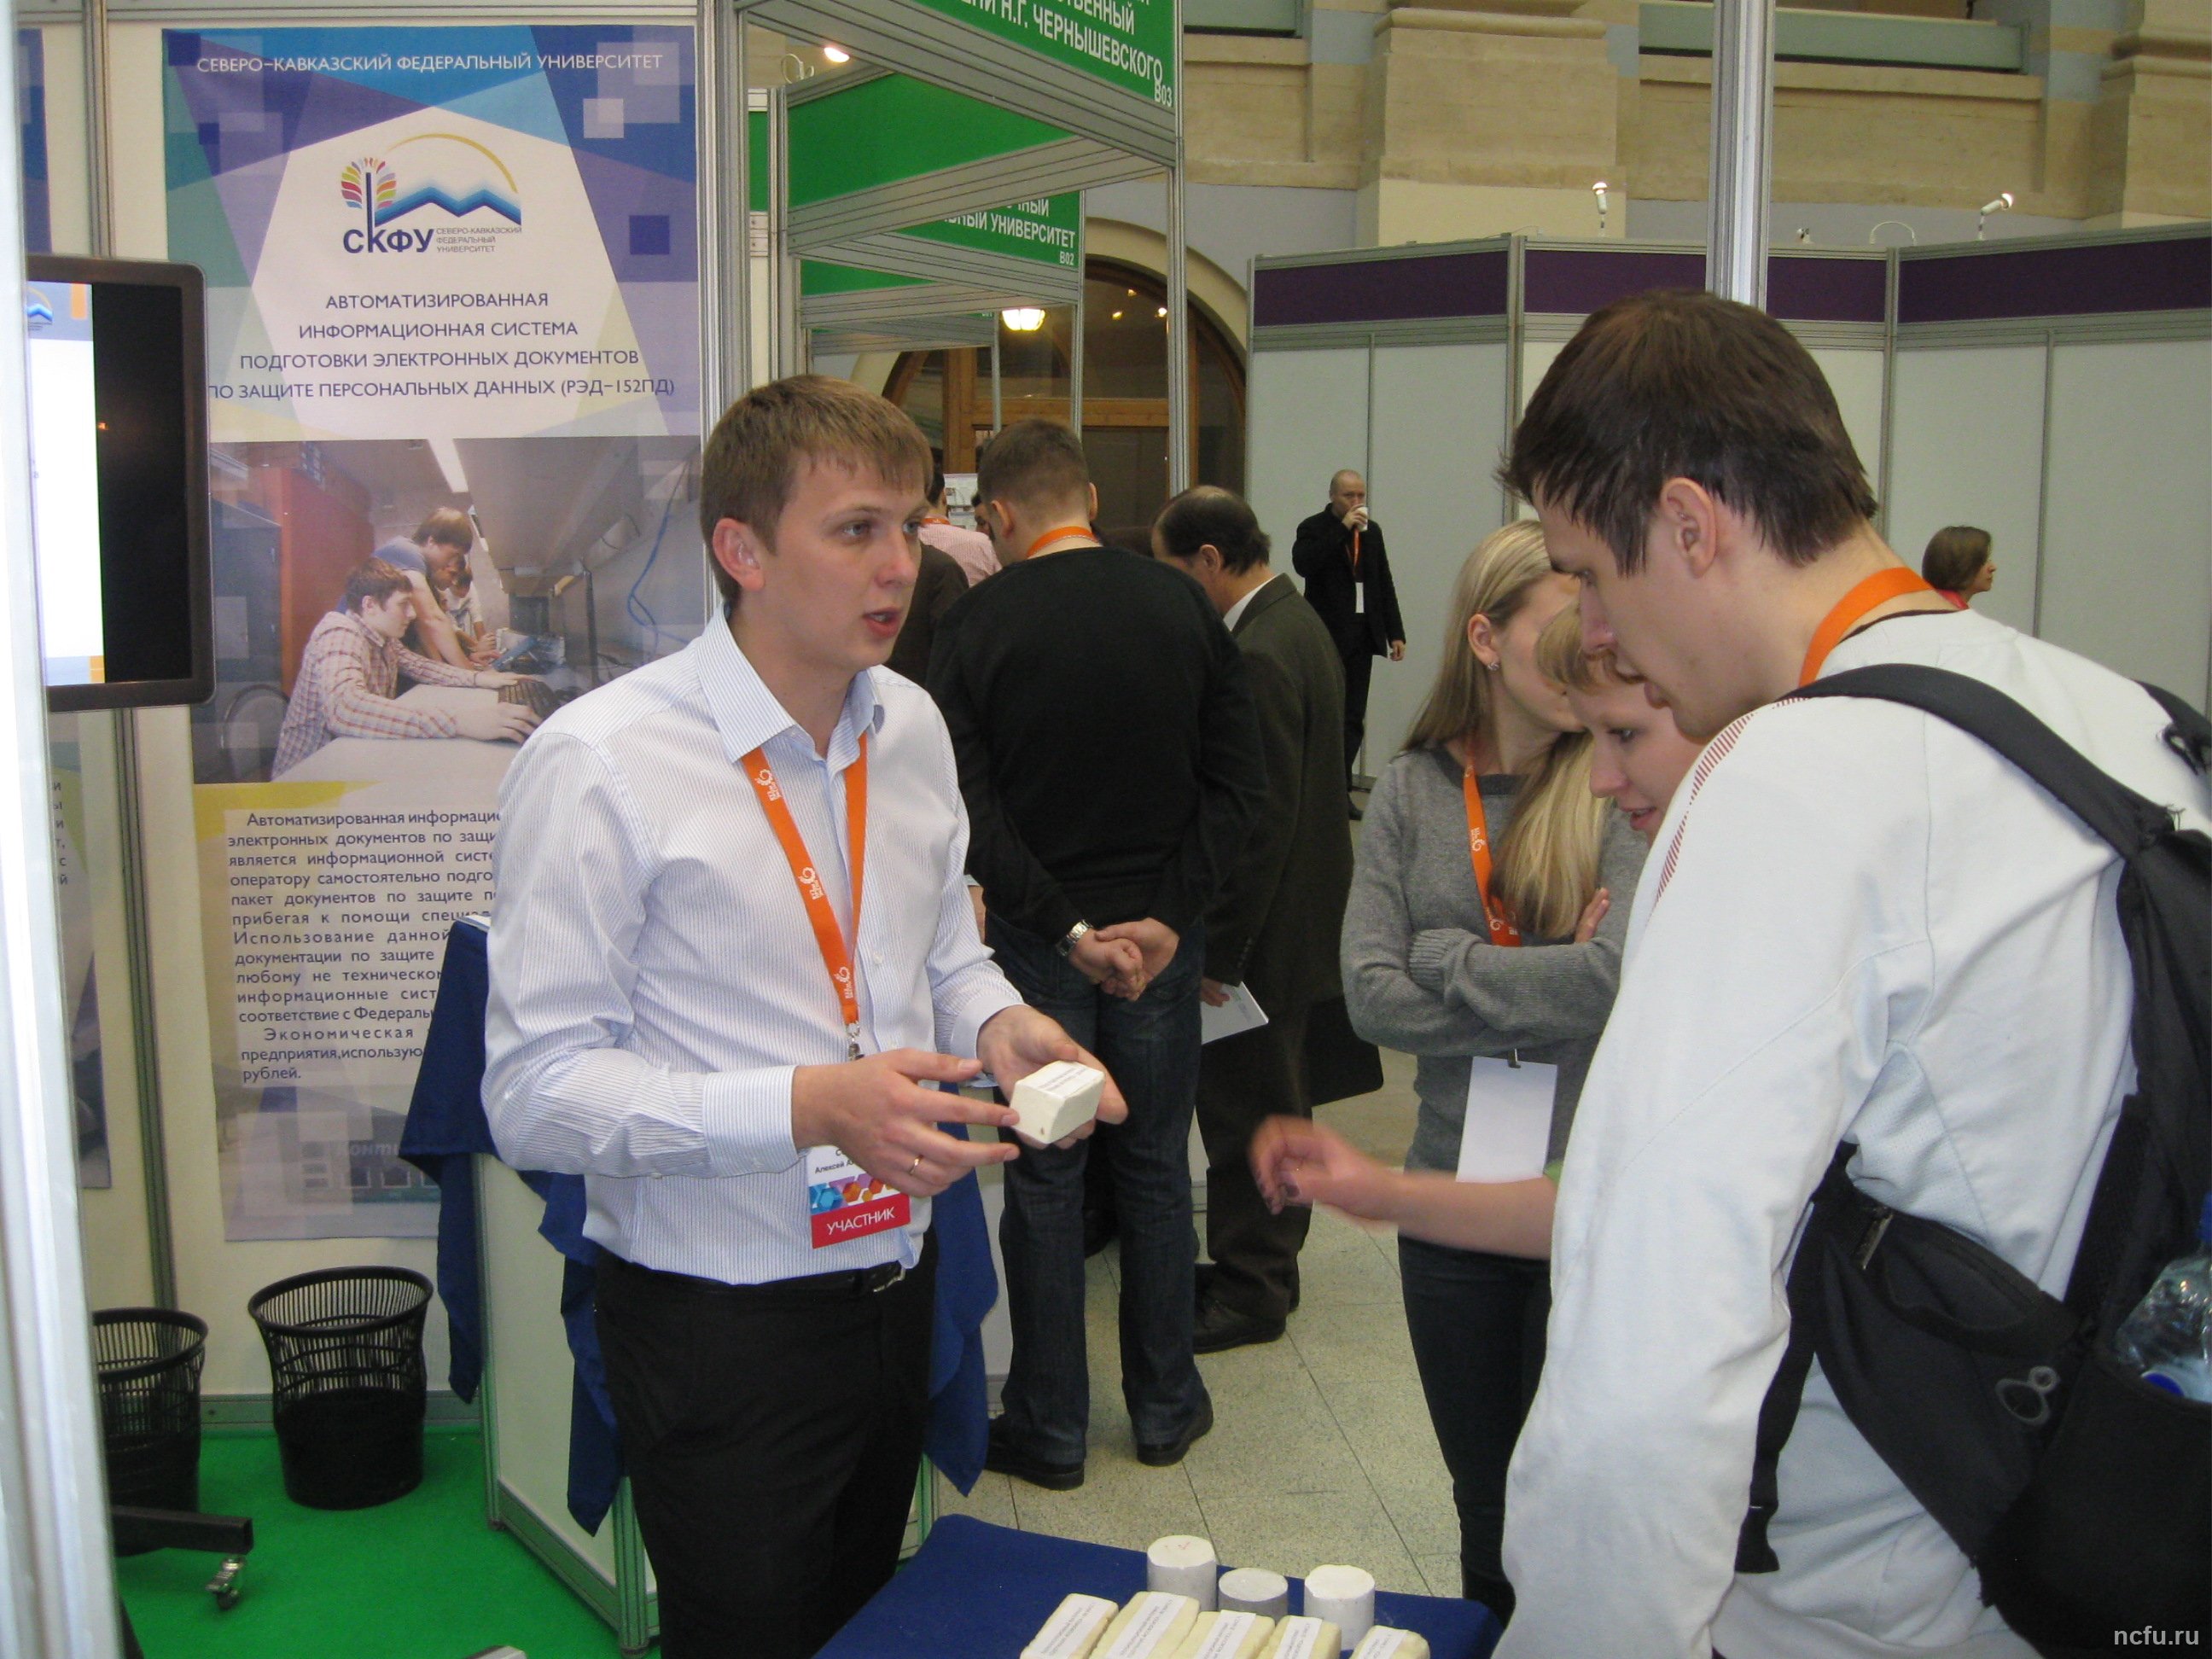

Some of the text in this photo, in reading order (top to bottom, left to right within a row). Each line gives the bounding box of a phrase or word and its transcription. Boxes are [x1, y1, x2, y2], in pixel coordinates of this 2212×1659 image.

[1033, 3, 1162, 83] ЧЕРНЫШЕВСКОГО
[197, 52, 663, 73] СЕВЕРО-КАВКАЗСКИЙ ФЕДЕРАЛЬНЫЙ УНИВЕРСИТЕТ
[990, 212, 1076, 249] УНИВЕРСИТЕТ
[436, 236, 497, 244] ФЕДЕРАЛЬНЫЙ
[436, 245, 497, 253] УНИВЕРСИТЕТ
[326, 293, 549, 311] АВТОМАТИЗИРОВАННАЯ
[299, 321, 579, 341] ИНФОРМАЦИОННАЯ СИСТЕМА
[241, 350, 639, 372] ПОДГОТОВКИ ЭЛЕКТРОННЫХ ДОКУМЕНТОВ
[239, 383, 314, 401] ЗАЩИТЕ
[320, 381, 469, 398] ПЕРСОНАЛЬНЫХ
[474, 380, 556, 399] ДАННЫХ
[561, 378, 675, 399] (РЭД-152ПД)
[247, 813, 405, 829] Автоматизированная
[228, 835, 329, 850] электронных
[336, 833, 426, 848] документов
[434, 833, 452, 843] по
[230, 855, 296, 866] является
[307, 851, 444, 868] информационной
[230, 871, 493, 889] оператору самостоятельно подго
[231, 894, 274, 906] пакет
[284, 894, 375, 908] документов
[387, 893, 406, 903] по
[417, 891, 473, 904] защите
[232, 911, 310, 928] прибегая
[322, 914, 330, 923] к
[341, 911, 410, 924] помощи
[234, 931, 375, 945] Использование
[235, 951, 434, 967] документации по защите
[236, 970, 301, 987] любому
[313, 971, 331, 982] не
[237, 990, 437, 1006] информационные сист
[239, 1006, 432, 1022] соответствие с Федераль
[264, 1027, 414, 1041] Экономическая
[243, 1067, 301, 1083] рублей.
[826, 1206, 896, 1235] УЧАСТНИК
